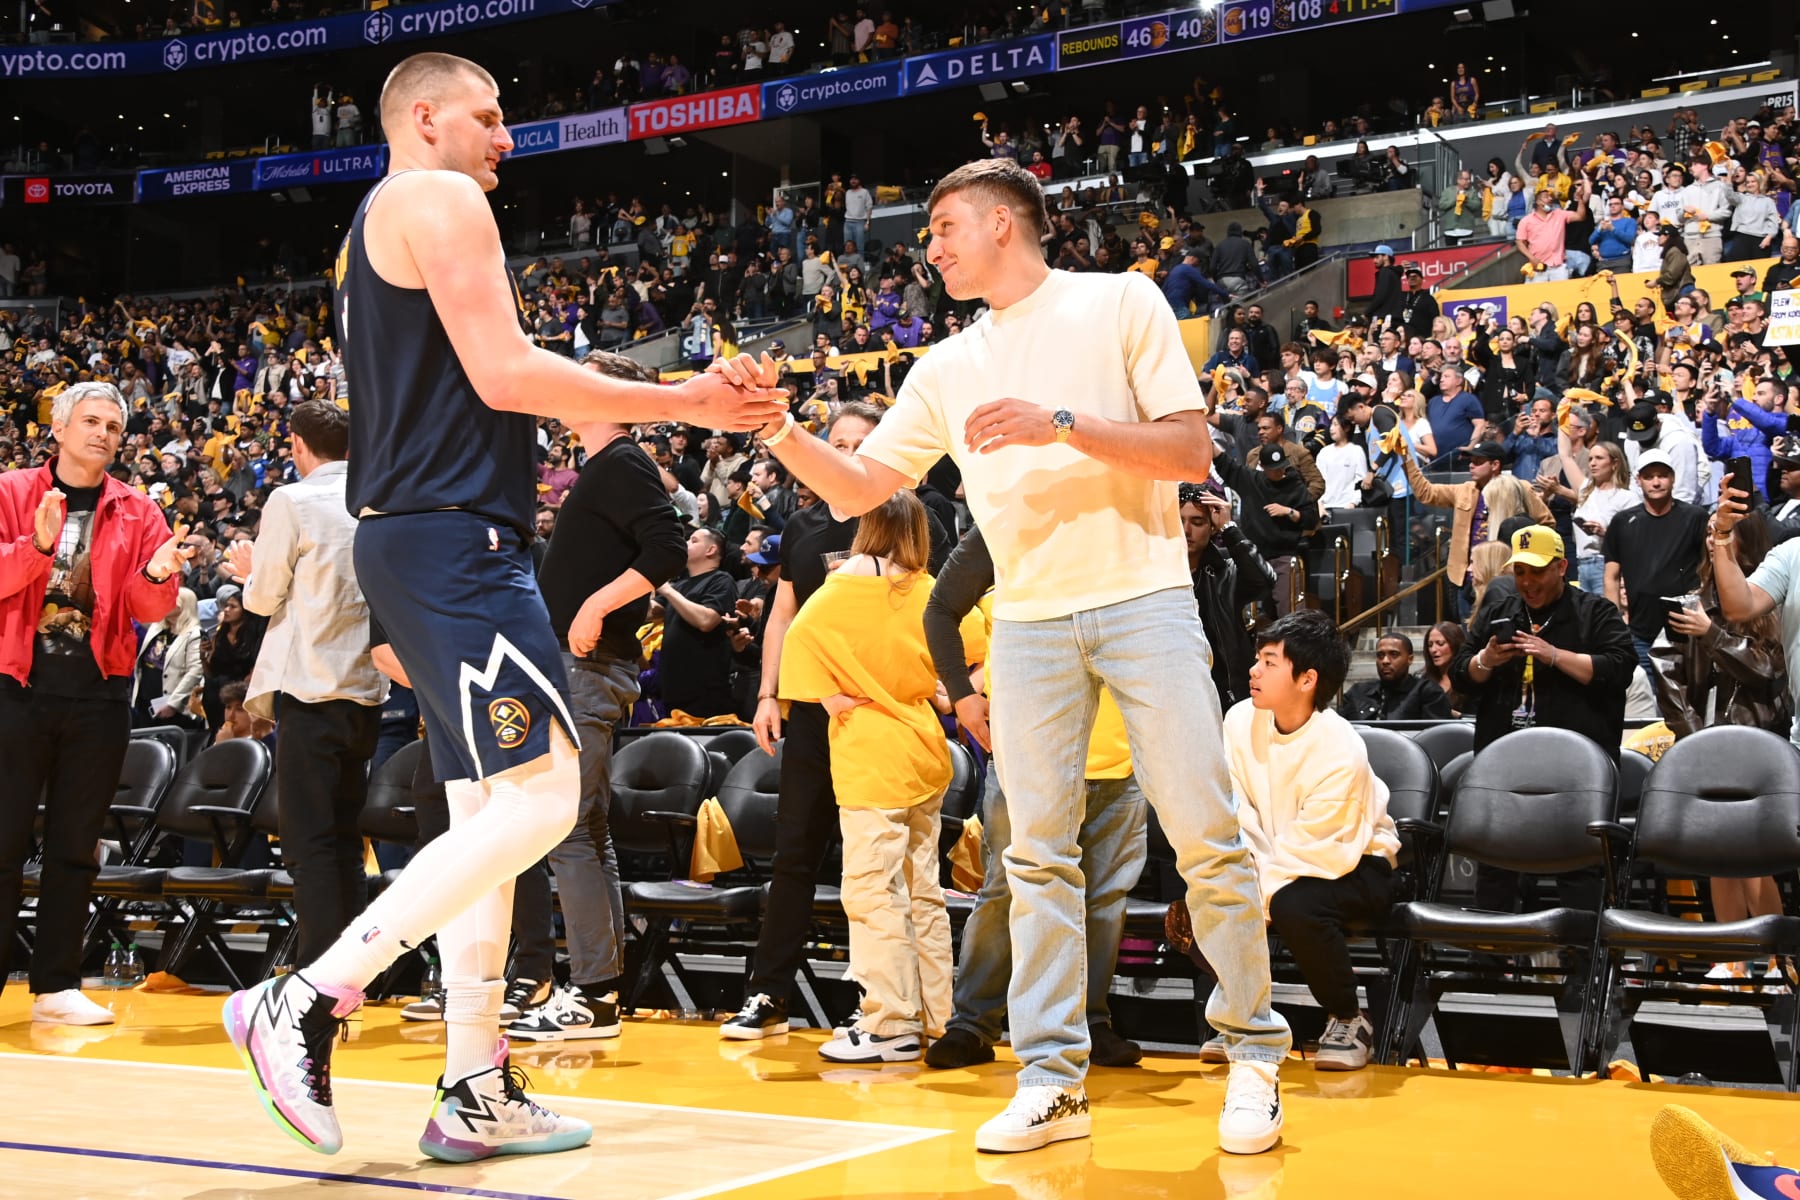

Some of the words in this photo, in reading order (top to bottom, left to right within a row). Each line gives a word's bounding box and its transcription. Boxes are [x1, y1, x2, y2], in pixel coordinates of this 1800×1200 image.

[400, 0, 535, 33] crypto.com
[1238, 6, 1271, 31] 119
[1287, 0, 1322, 22] 108
[1328, 0, 1339, 14] 4
[194, 25, 327, 62] crypto.com
[1061, 34, 1119, 56] REBOUNDS
[1126, 26, 1151, 48] 46
[1176, 18, 1202, 39] 40
[1, 50, 126, 76] ypto.com
[947, 45, 1044, 80] DELTA
[800, 73, 888, 101] crypto.com
[633, 92, 754, 132] TOSHIBA
[516, 129, 554, 149] UCLA
[563, 116, 620, 143] Health
[163, 166, 231, 185] AMERICAN
[261, 163, 311, 182] Michelob
[322, 156, 374, 174] ULTRA
[54, 182, 114, 197] TOYOTA
[172, 178, 231, 196] EXPRESS
[1647, 743, 1669, 751] TKE
